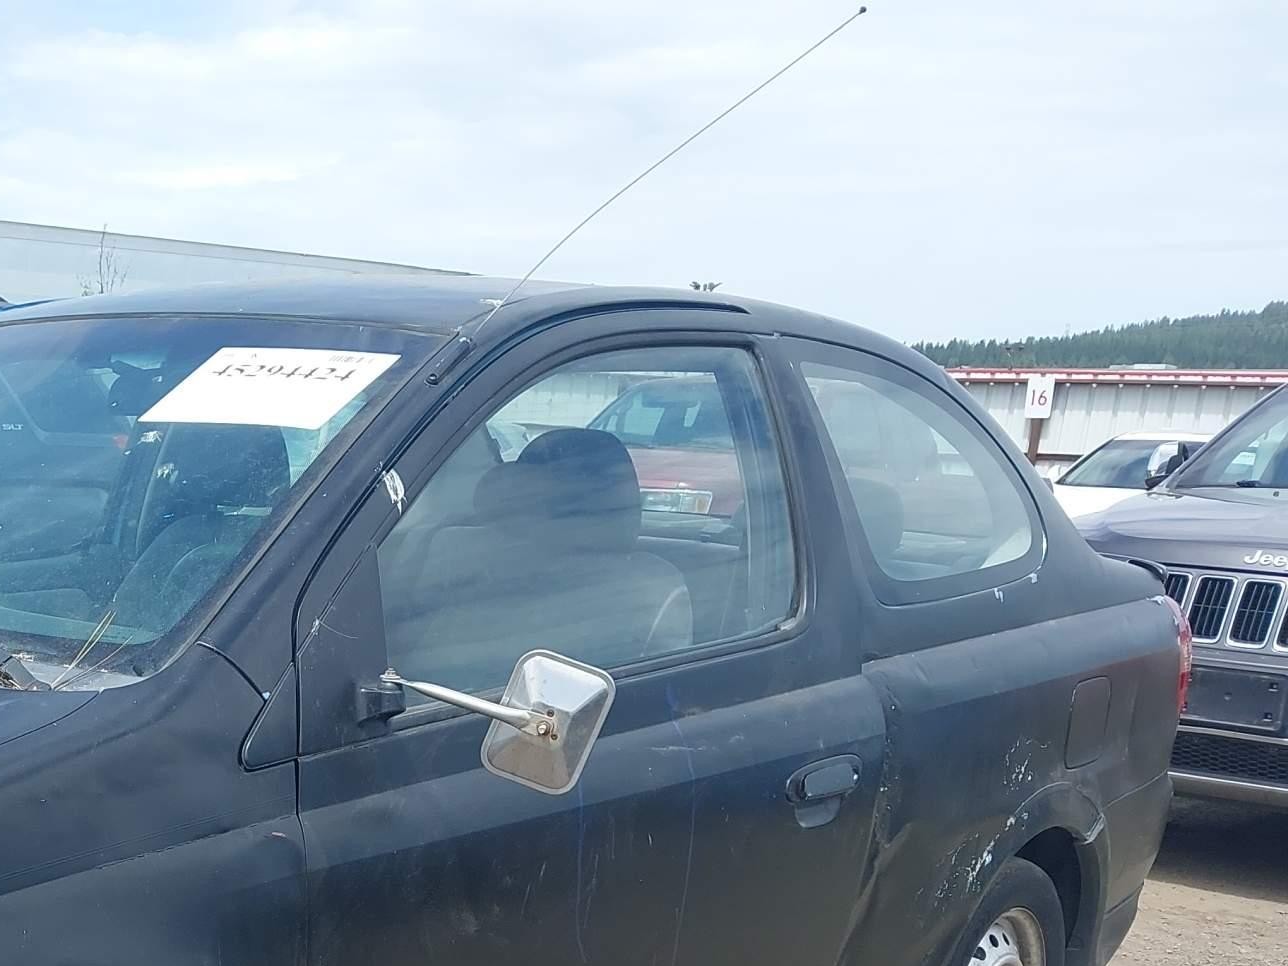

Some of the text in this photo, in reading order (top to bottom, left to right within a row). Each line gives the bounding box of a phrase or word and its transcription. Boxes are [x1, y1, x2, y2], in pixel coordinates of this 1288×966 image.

[212, 364, 357, 381] 45294424
[1031, 389, 1048, 407] 16
[1, 423, 24, 431] SLT
